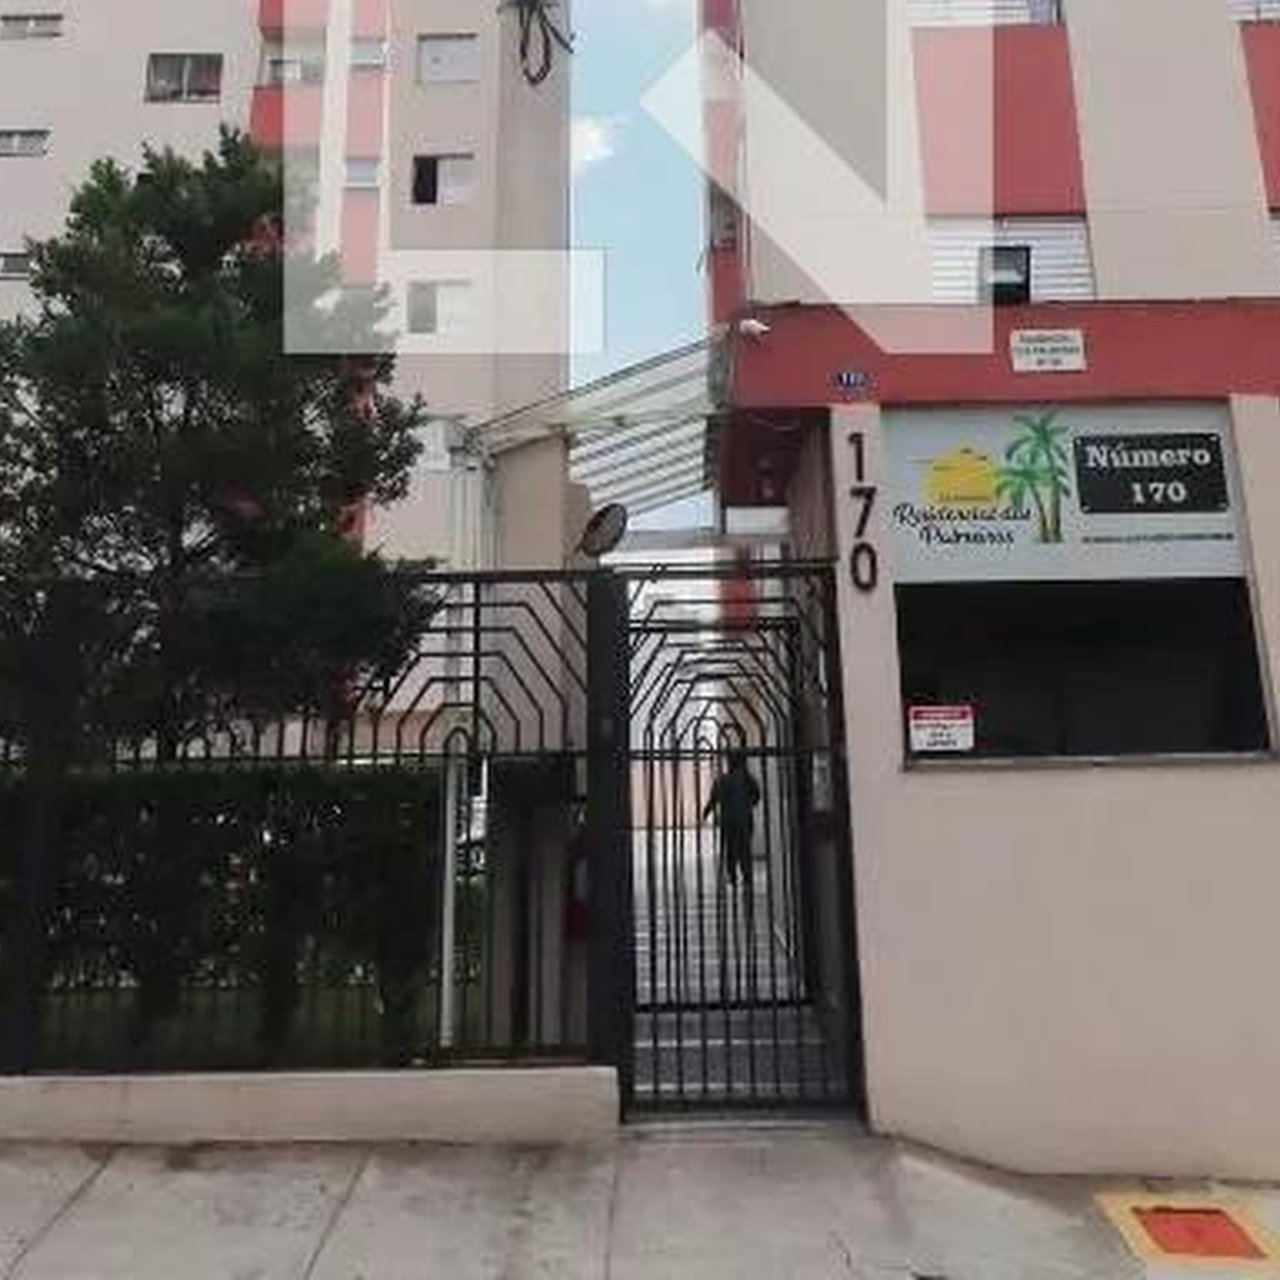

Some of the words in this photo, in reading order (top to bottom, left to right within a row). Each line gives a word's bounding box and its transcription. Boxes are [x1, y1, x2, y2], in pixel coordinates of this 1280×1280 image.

[1084, 441, 1212, 469] Número
[1130, 480, 1188, 505] 170
[848, 432, 877, 593] 170
